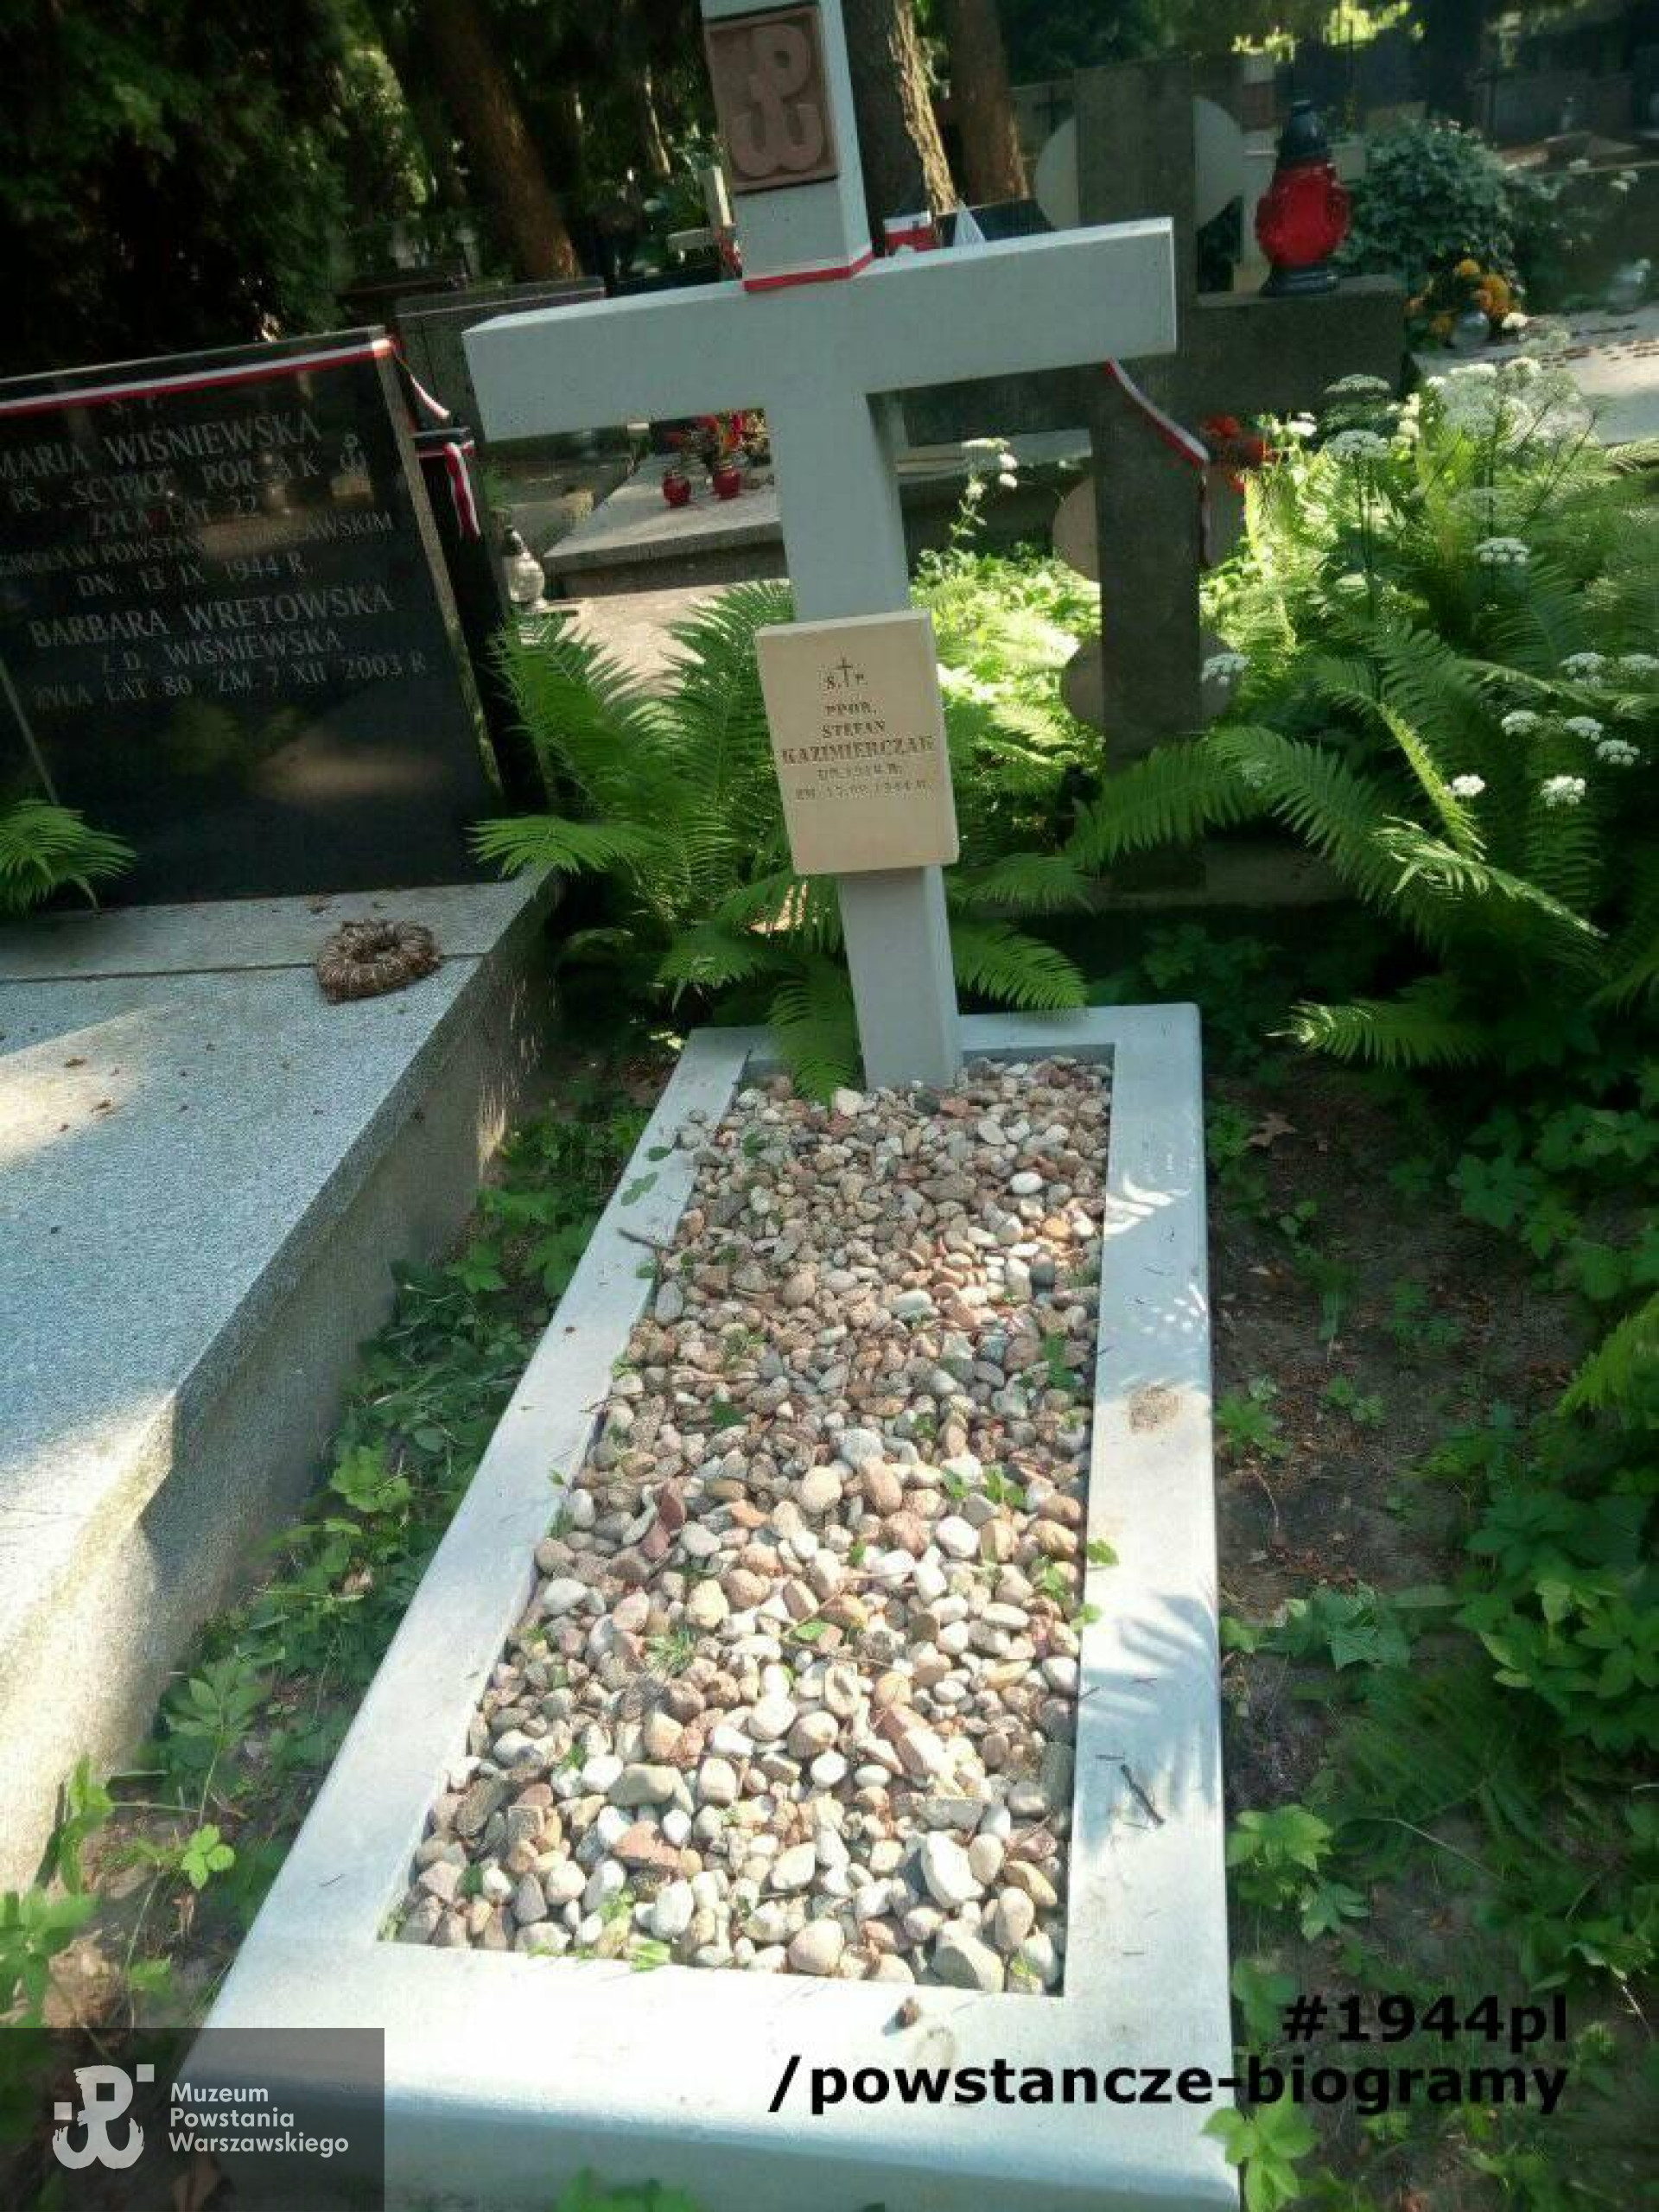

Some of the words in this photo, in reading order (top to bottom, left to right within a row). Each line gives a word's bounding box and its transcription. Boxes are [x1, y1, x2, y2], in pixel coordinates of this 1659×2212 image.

[27, 607, 171, 648] BARBARA
[822, 720, 886, 739] STEFAN
[781, 734, 936, 765] KAZIMIERCZAK
